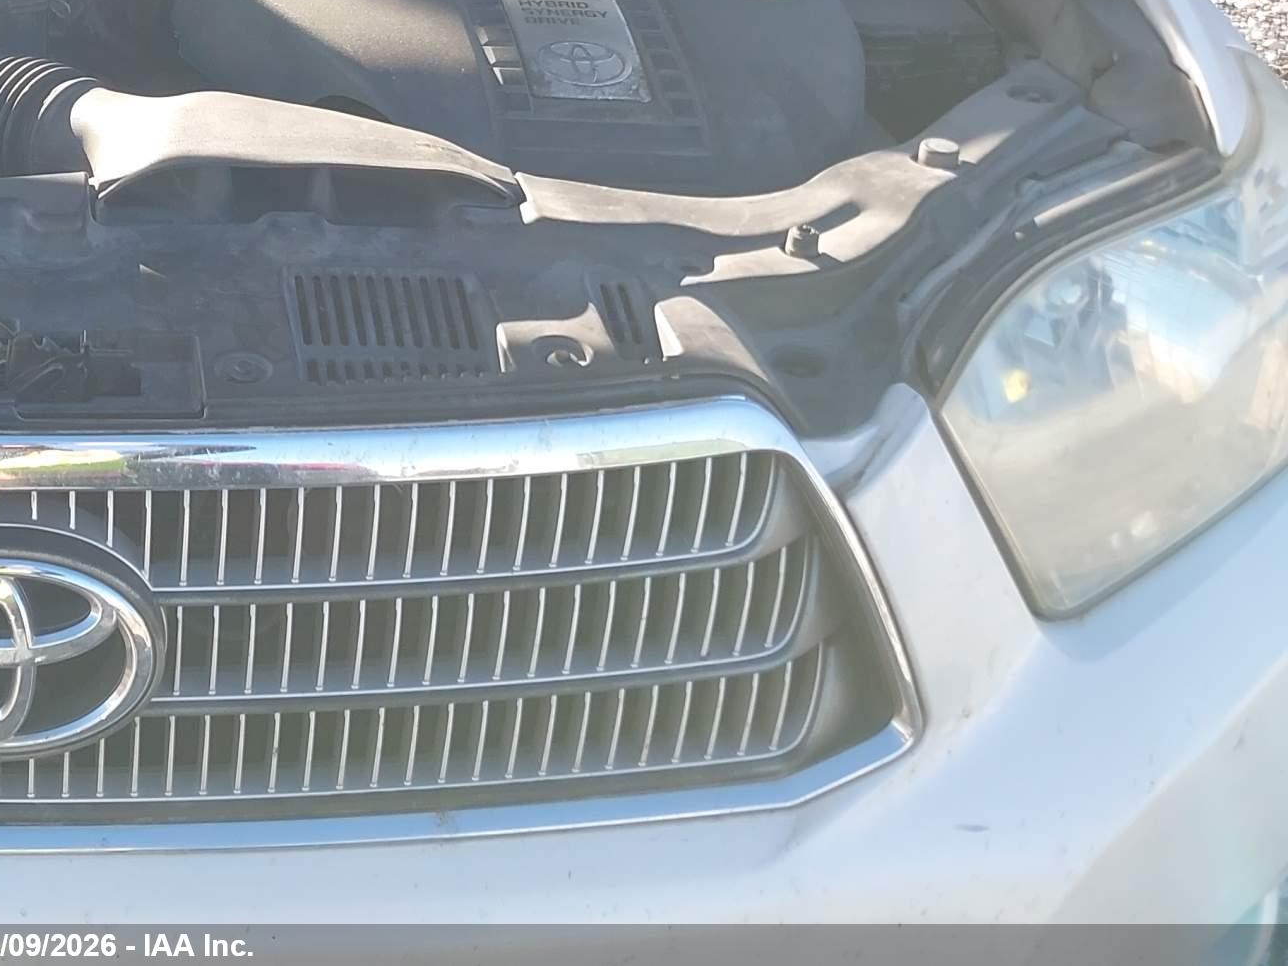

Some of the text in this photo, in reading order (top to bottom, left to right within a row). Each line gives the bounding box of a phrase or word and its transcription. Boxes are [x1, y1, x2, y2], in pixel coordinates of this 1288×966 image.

[518, 0, 589, 9] HYBRID
[521, 8, 608, 18] SYNERGY
[524, 16, 581, 25] DRIVE
